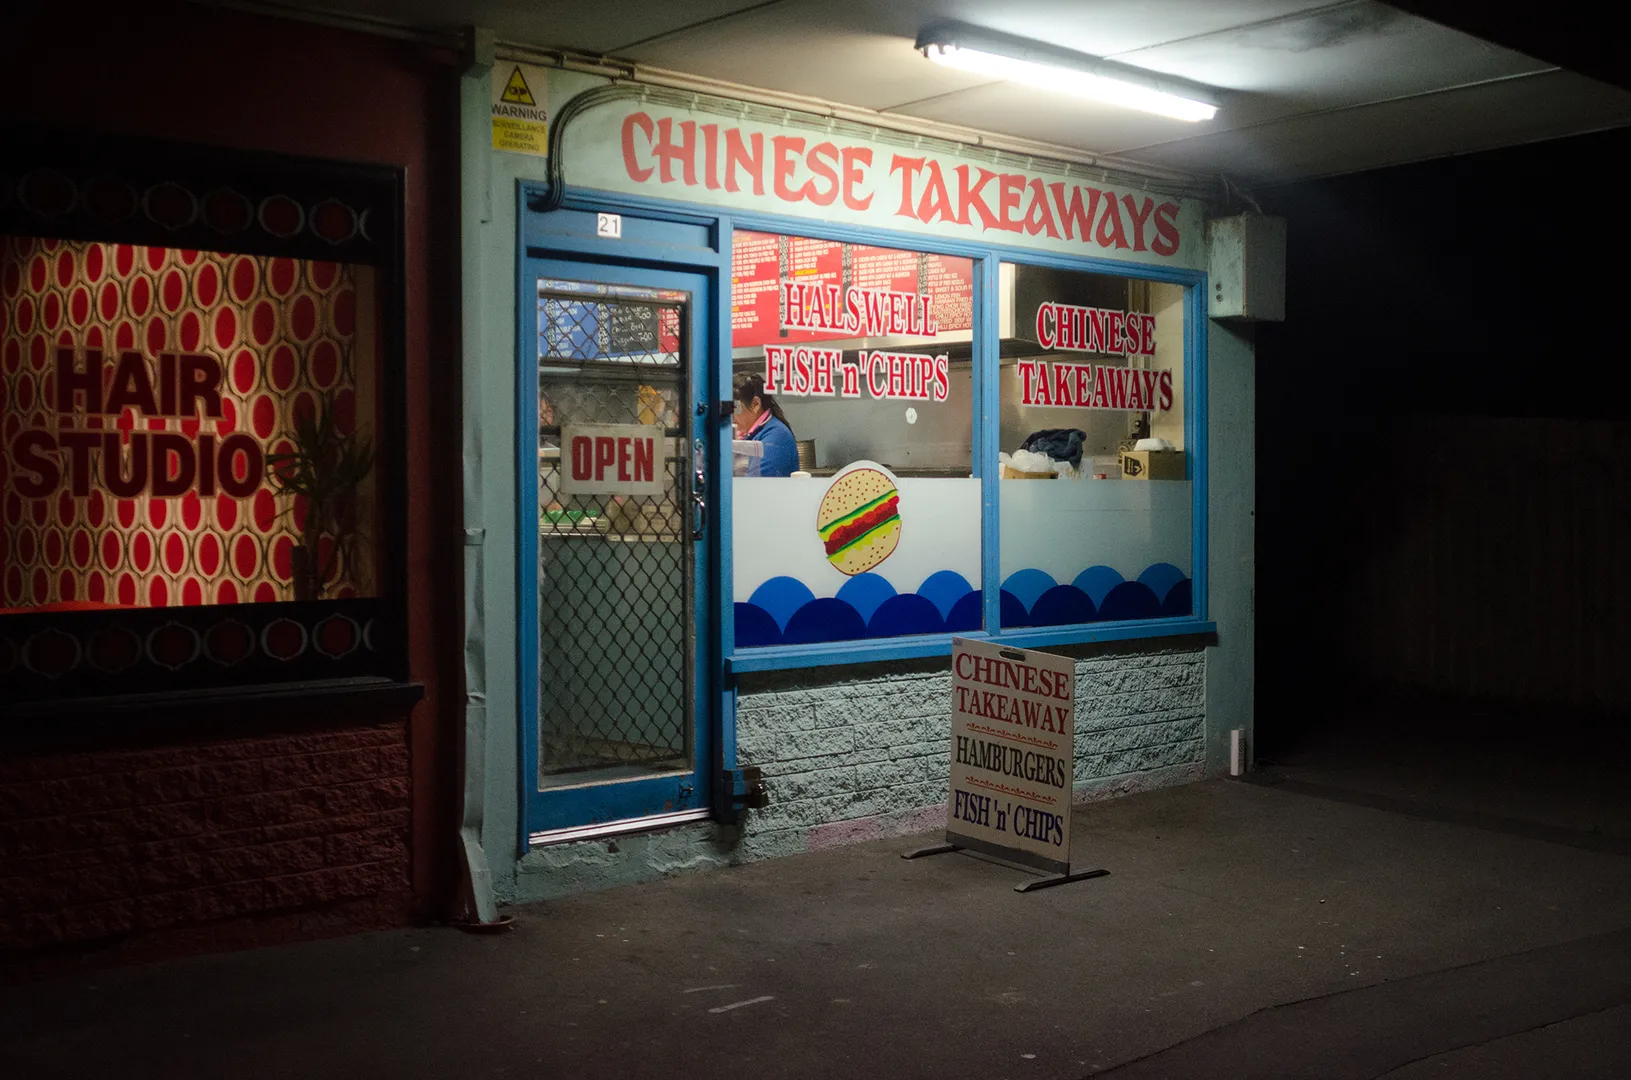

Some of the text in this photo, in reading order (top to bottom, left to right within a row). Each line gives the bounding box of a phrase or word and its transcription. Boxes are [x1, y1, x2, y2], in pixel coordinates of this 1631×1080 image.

[491, 103, 547, 121] WARNING
[621, 111, 875, 211] CHINESE
[889, 153, 1180, 257] TAKEAWAYS
[599, 216, 619, 234] 21
[781, 281, 938, 338] HALSWELL
[1037, 303, 1157, 356] CHINESE
[56, 348, 224, 419] HAIR
[1018, 361, 1173, 412] TAKEAWAYS
[10, 429, 265, 499] STUDIO
[571, 435, 654, 482] OPEN
[955, 652, 1070, 700] CHINESE
[956, 686, 1070, 735] TAKEAWAY
[956, 735, 1065, 789] HAMBURGERS
[954, 789, 1064, 847] FISH 'n' CHIPS
